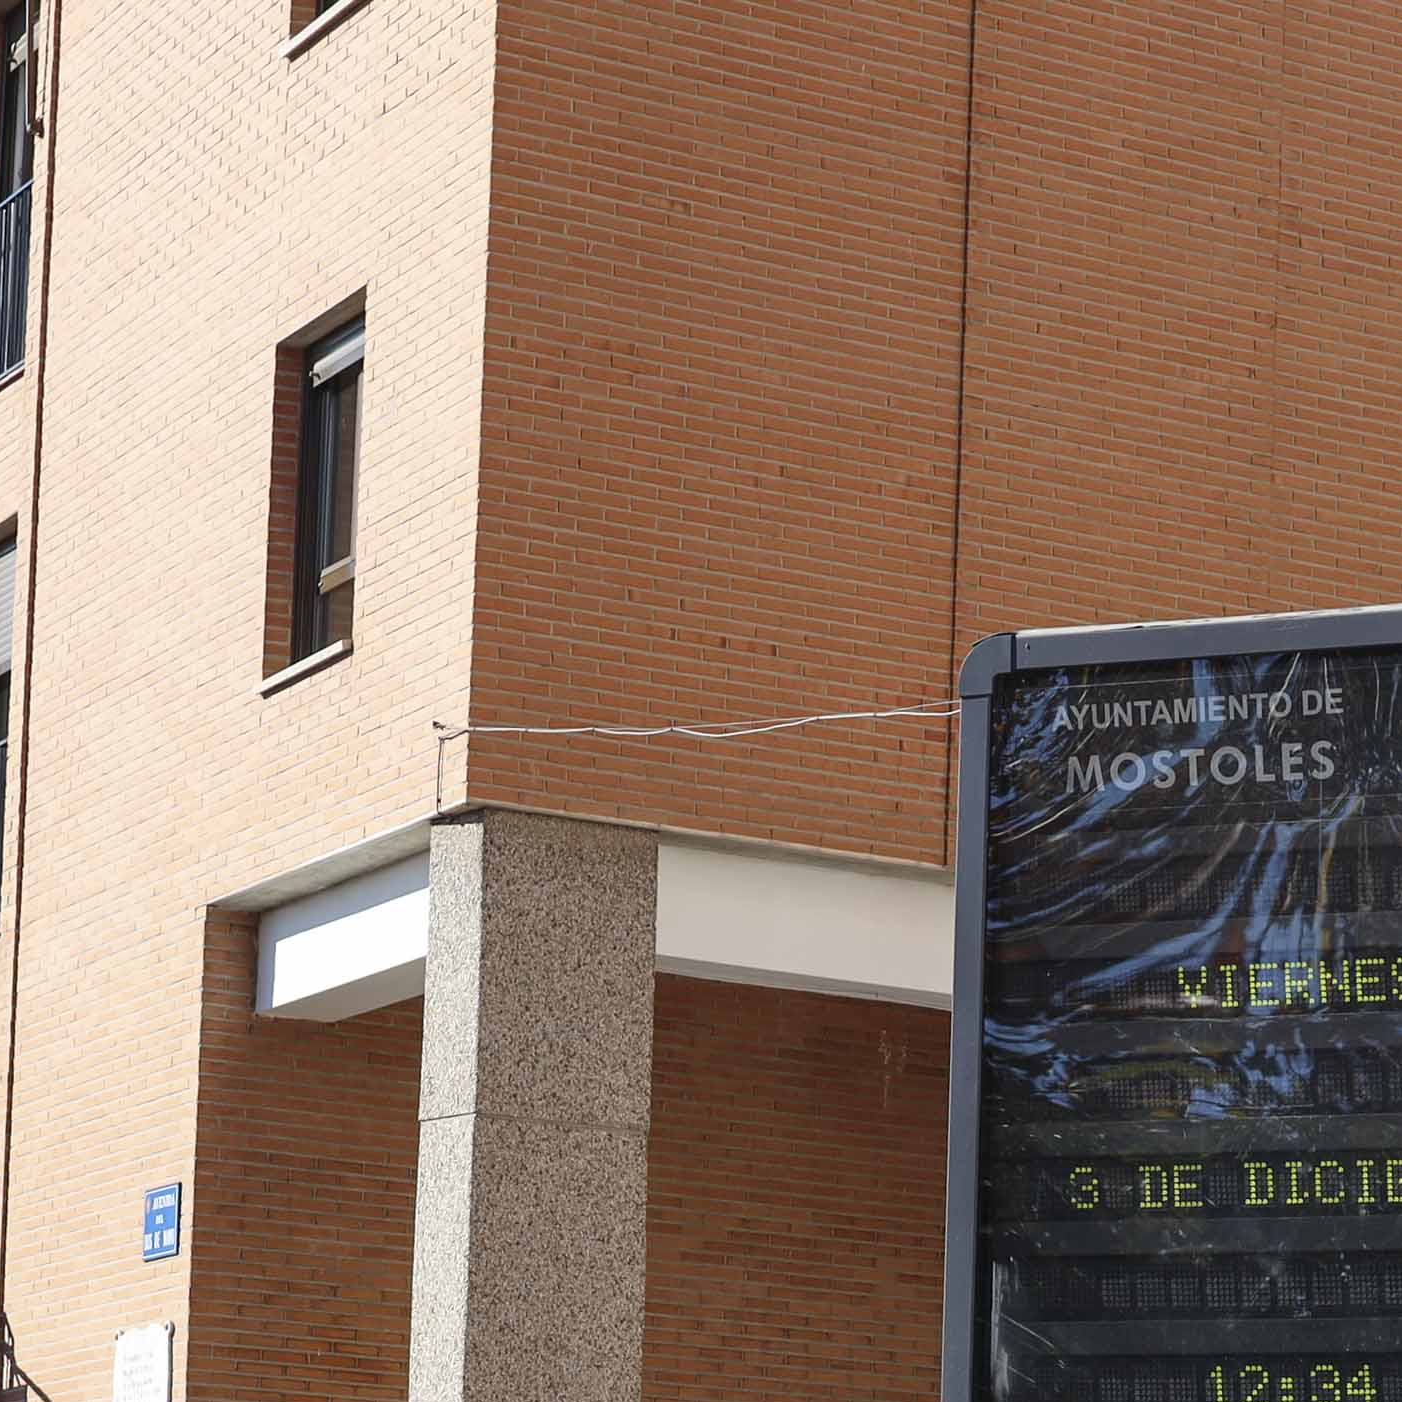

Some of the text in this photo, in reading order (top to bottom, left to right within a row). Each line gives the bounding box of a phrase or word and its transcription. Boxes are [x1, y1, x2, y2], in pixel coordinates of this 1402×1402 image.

[1051, 688, 1345, 732] AYUNTAMIENTO DE
[1065, 740, 1336, 793] MOSTOLES
[1069, 1166, 1099, 1209] 3
[1138, 1164, 1203, 1208] DE
